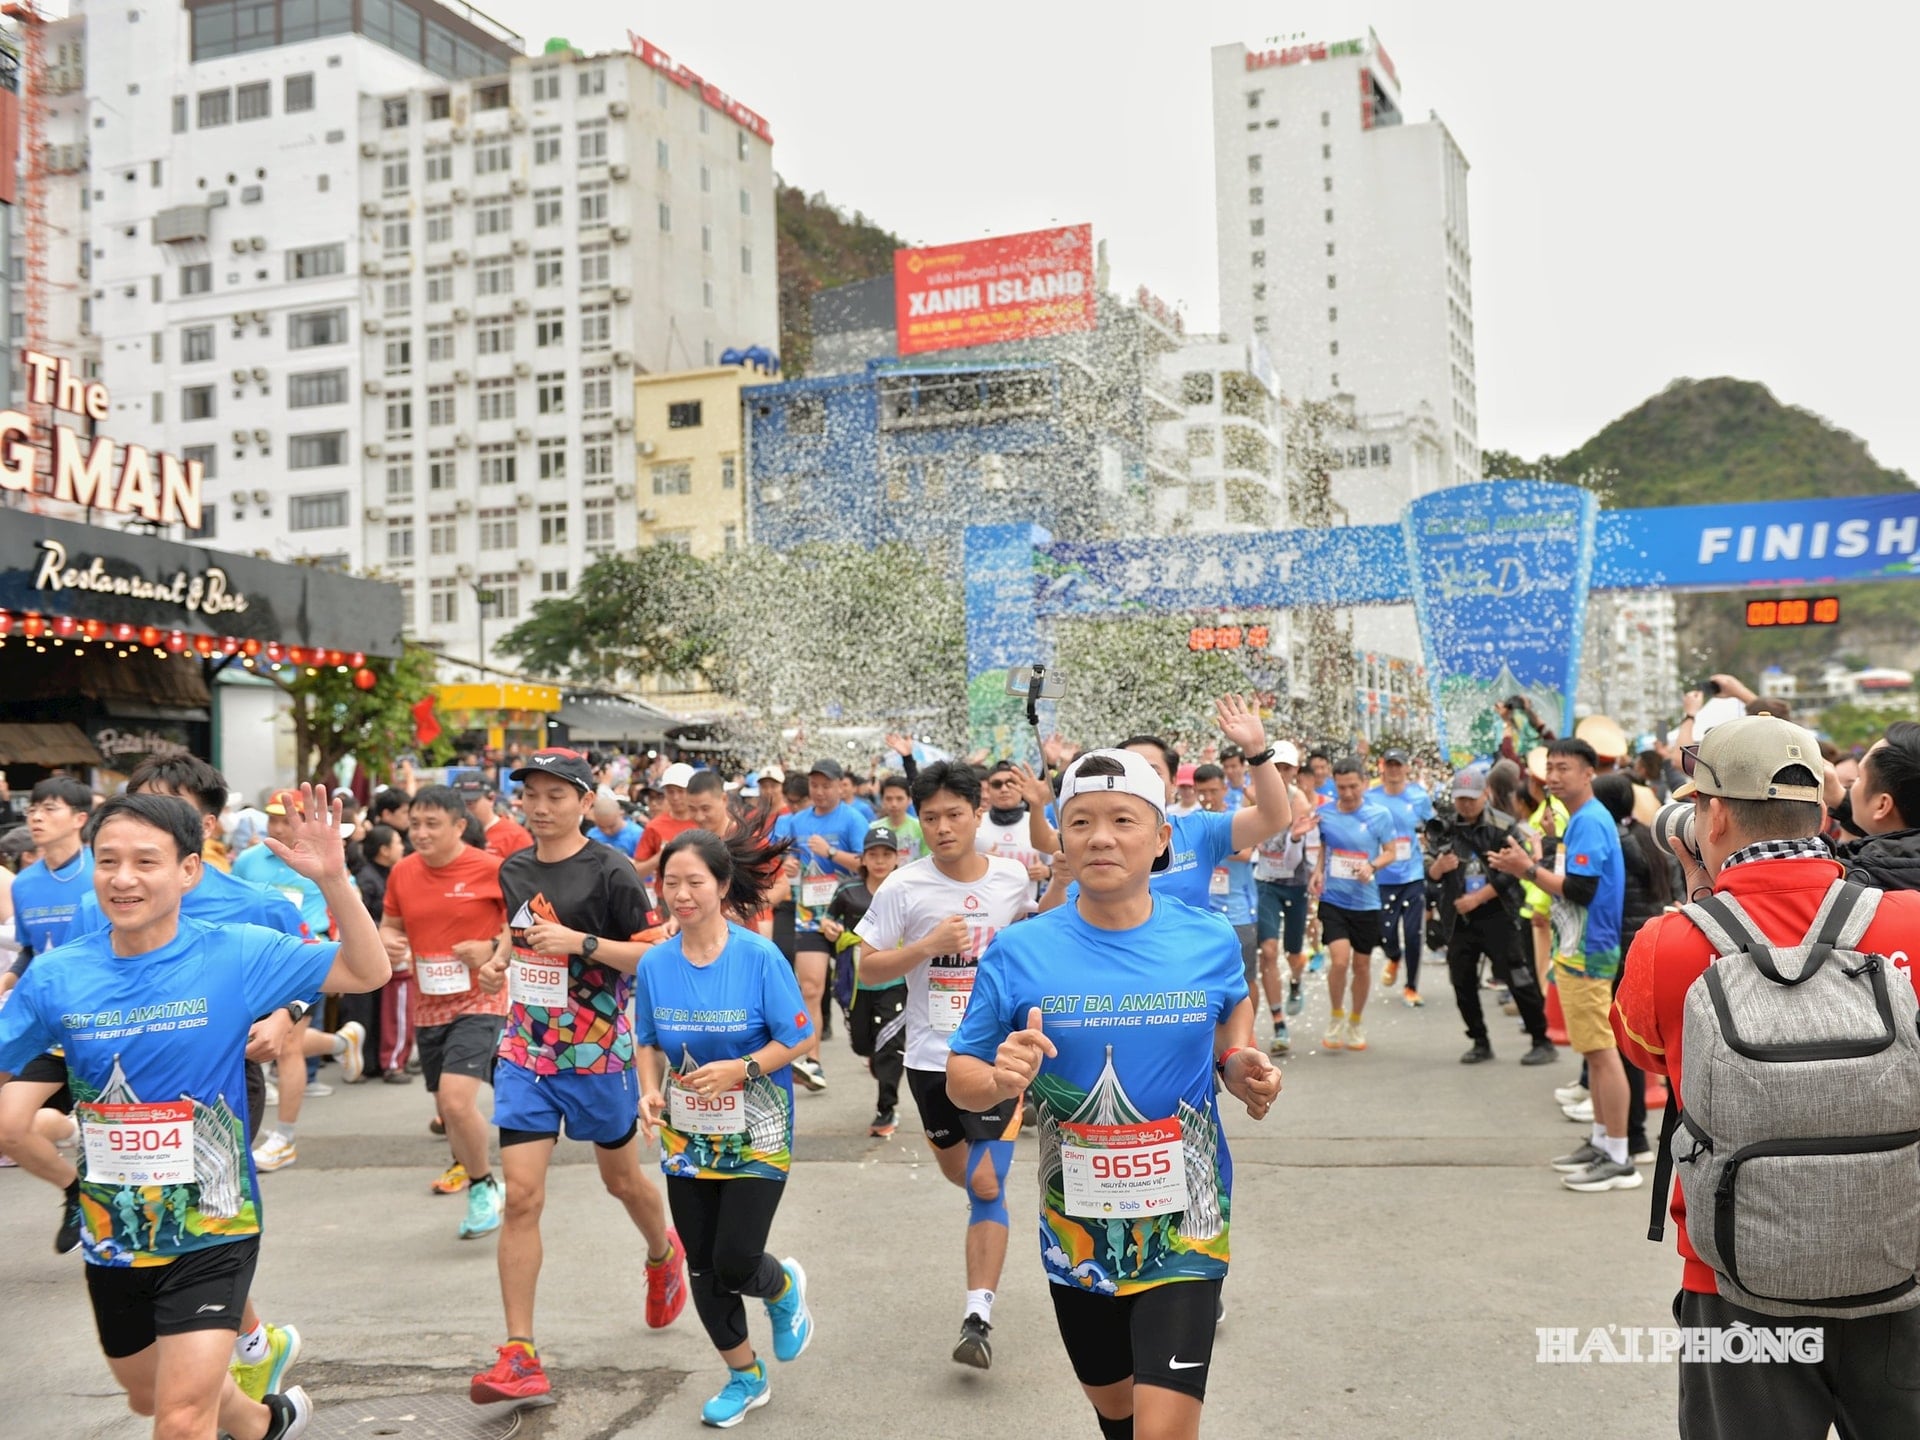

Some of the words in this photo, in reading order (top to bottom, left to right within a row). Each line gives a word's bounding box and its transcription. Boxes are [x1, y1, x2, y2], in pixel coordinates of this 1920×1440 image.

[908, 285, 981, 318] XANH
[987, 271, 1084, 307] ISLAND
[22, 350, 109, 421] The
[54, 424, 203, 530] MAN
[1698, 517, 1919, 565] FINISH
[35, 540, 187, 603] Restaurant
[202, 567, 249, 614] Bar
[1124, 551, 1301, 591] START
[426, 964, 464, 978] 9484
[520, 967, 560, 985] 9698
[95, 1010, 121, 1028] BA
[125, 998, 208, 1025] AMATINA
[1041, 995, 1081, 1014] CAT
[1083, 994, 1113, 1012] BA
[1118, 990, 1208, 1012] AMATINA
[672, 1009, 689, 1022] BA
[690, 1008, 747, 1023] AMATINA
[1084, 1016, 1141, 1027] HERITAGE
[1145, 1014, 1179, 1025] ROAD
[1181, 1013, 1207, 1023] 2025
[95, 1025, 144, 1039] HERITAGE
[146, 1021, 175, 1033] ROAD
[178, 1017, 208, 1029] 2025
[671, 1024, 703, 1032] HERITAGE
[727, 1024, 747, 1032] 2025
[109, 1128, 182, 1151] 9304
[1065, 1151, 1085, 1161] 21km
[1092, 1150, 1171, 1179] 9655
[1129, 1180, 1151, 1188] QUANG
